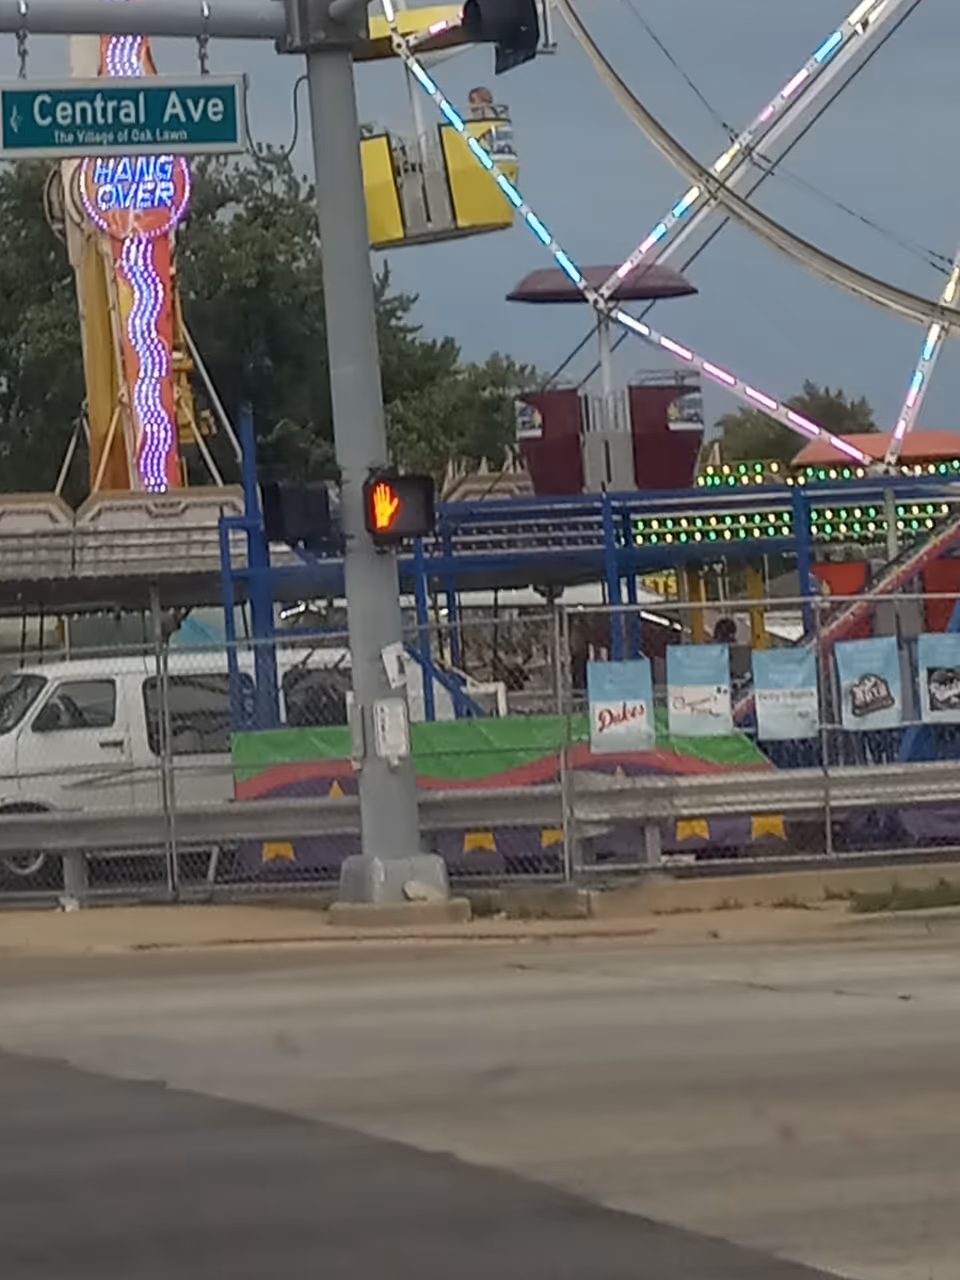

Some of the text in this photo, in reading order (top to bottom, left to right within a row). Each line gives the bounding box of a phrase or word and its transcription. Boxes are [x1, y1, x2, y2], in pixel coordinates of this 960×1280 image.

[33, 90, 225, 126] Central Ave
[54, 128, 188, 145] The Village of Oak Lawn
[93, 155, 174, 183] HANG
[97, 180, 175, 210] OVER
